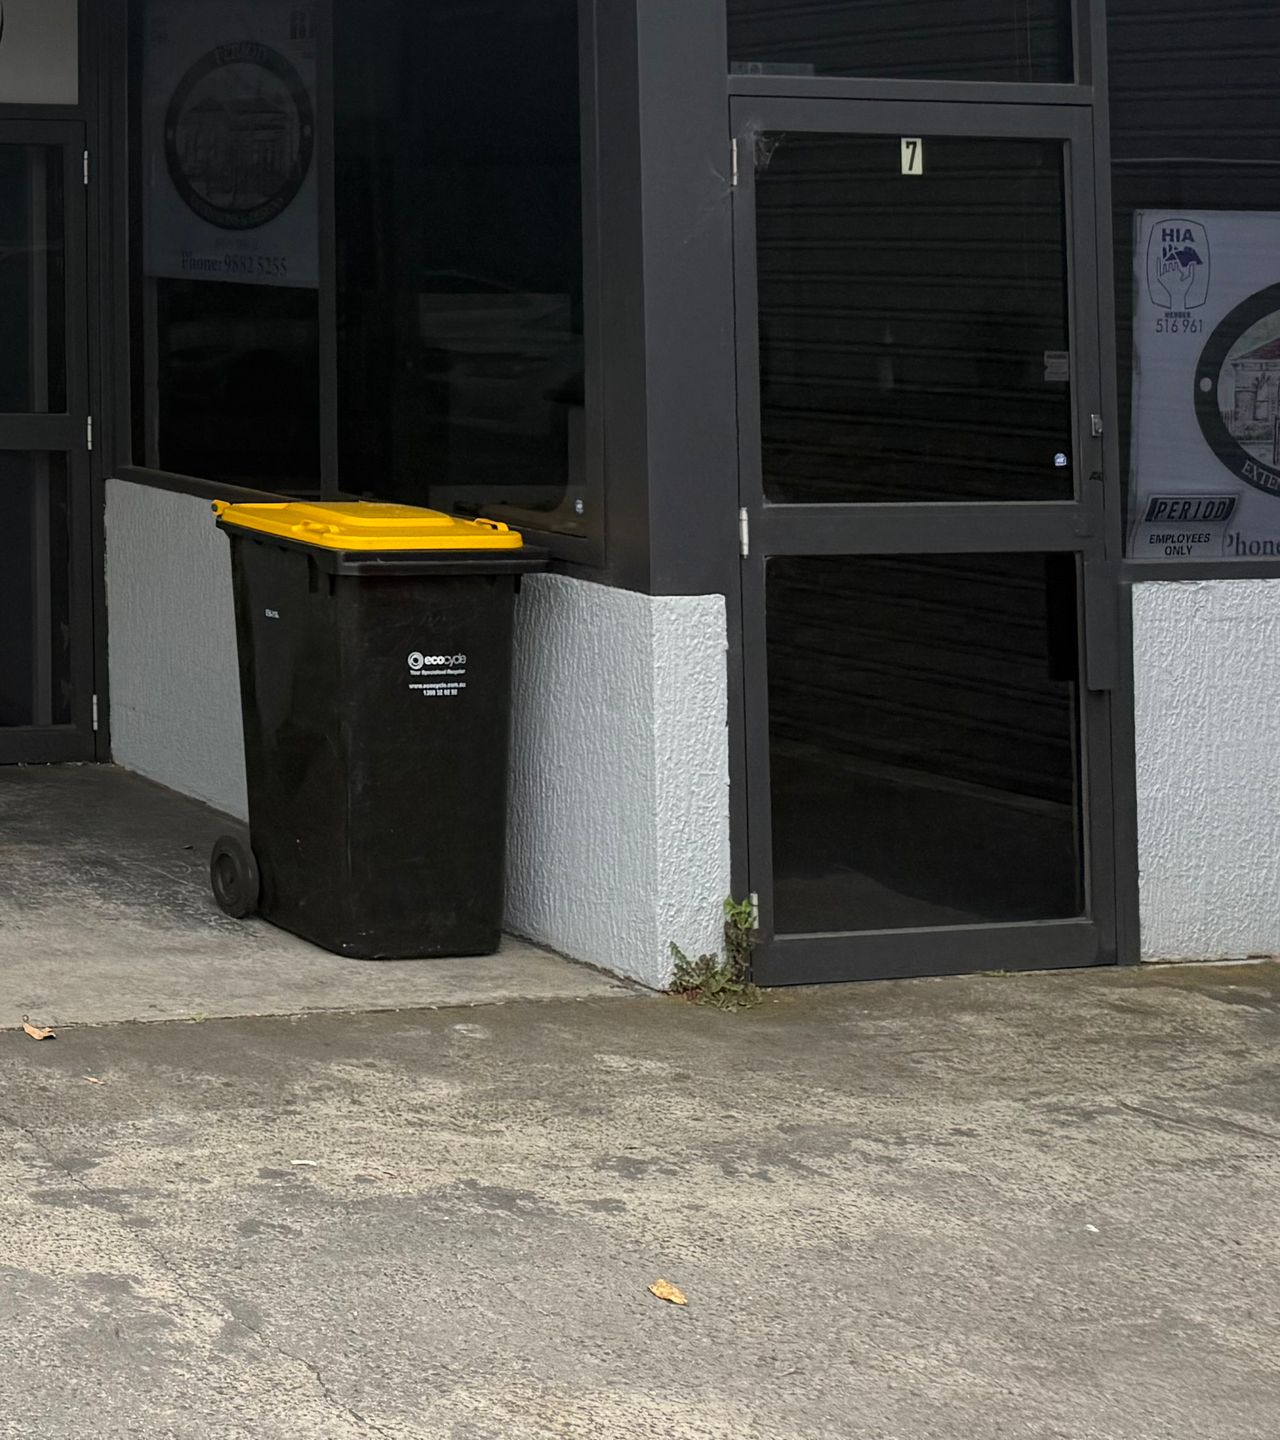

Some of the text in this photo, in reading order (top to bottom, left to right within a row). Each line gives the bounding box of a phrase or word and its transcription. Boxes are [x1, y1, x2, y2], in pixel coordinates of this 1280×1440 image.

[906, 140, 917, 172] 7
[1161, 228, 1195, 242] HIA
[1156, 318, 1203, 333] 516 961
[1153, 500, 1227, 520] PERIOD
[1149, 532, 1211, 544] EMPLOYEES
[1164, 545, 1193, 556] ONLY
